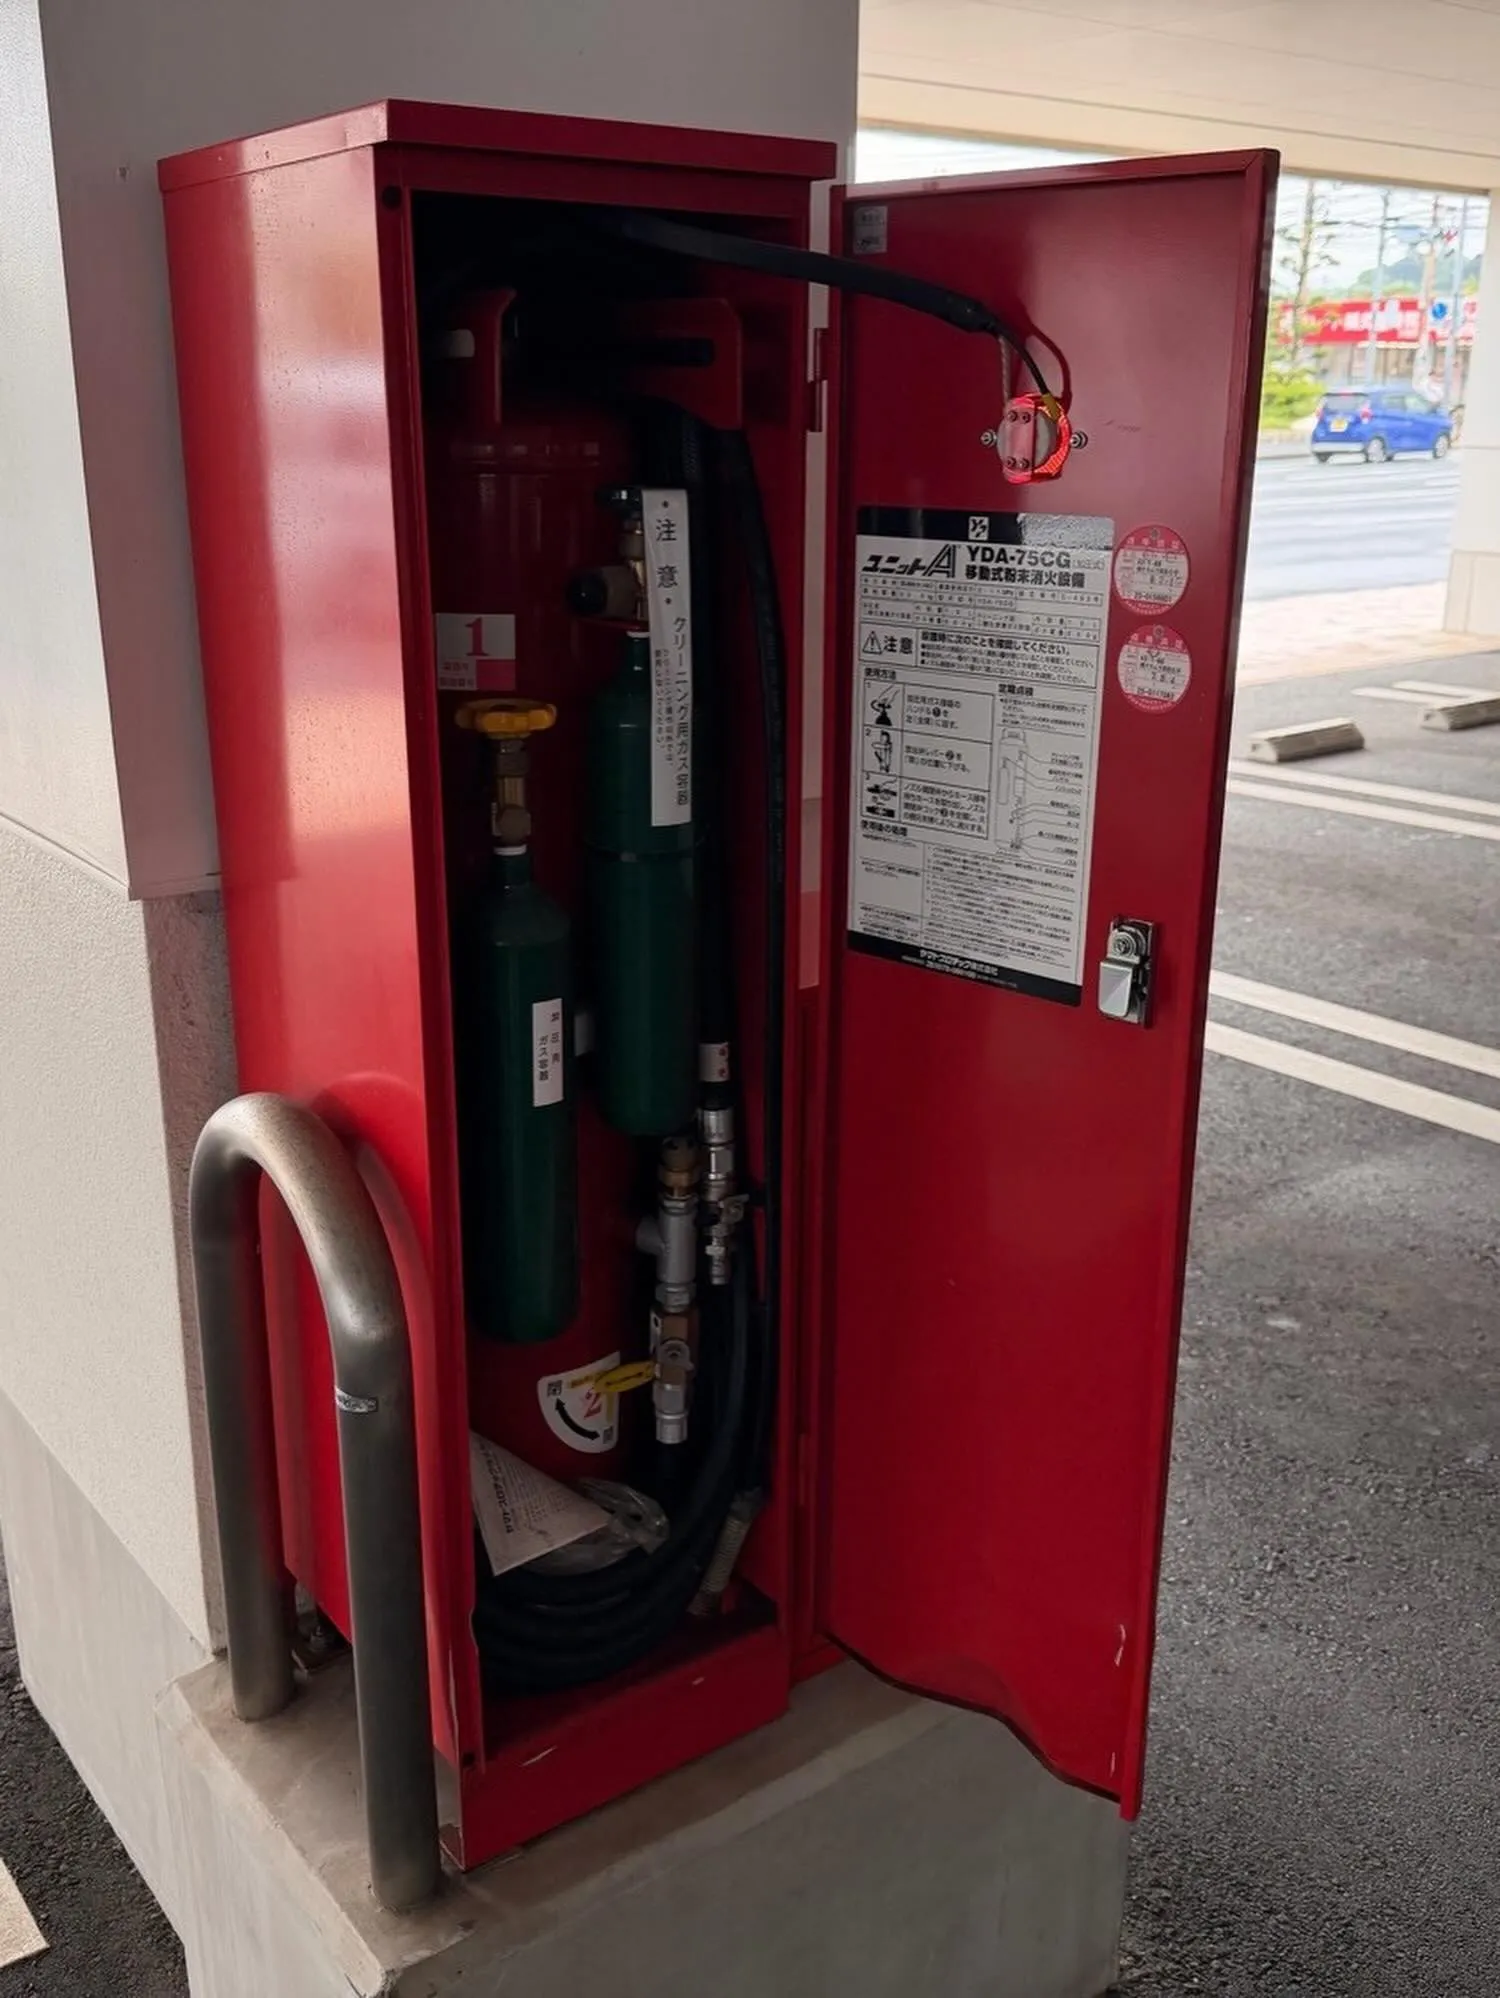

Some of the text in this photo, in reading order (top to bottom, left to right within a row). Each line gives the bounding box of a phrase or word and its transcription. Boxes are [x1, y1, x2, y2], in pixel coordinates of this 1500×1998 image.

[966, 545, 1071, 569] YDA-75CG
[964, 564, 1085, 588] 移動式粉末消火設備
[464, 616, 490, 657] 1
[883, 635, 913, 655] 注意
